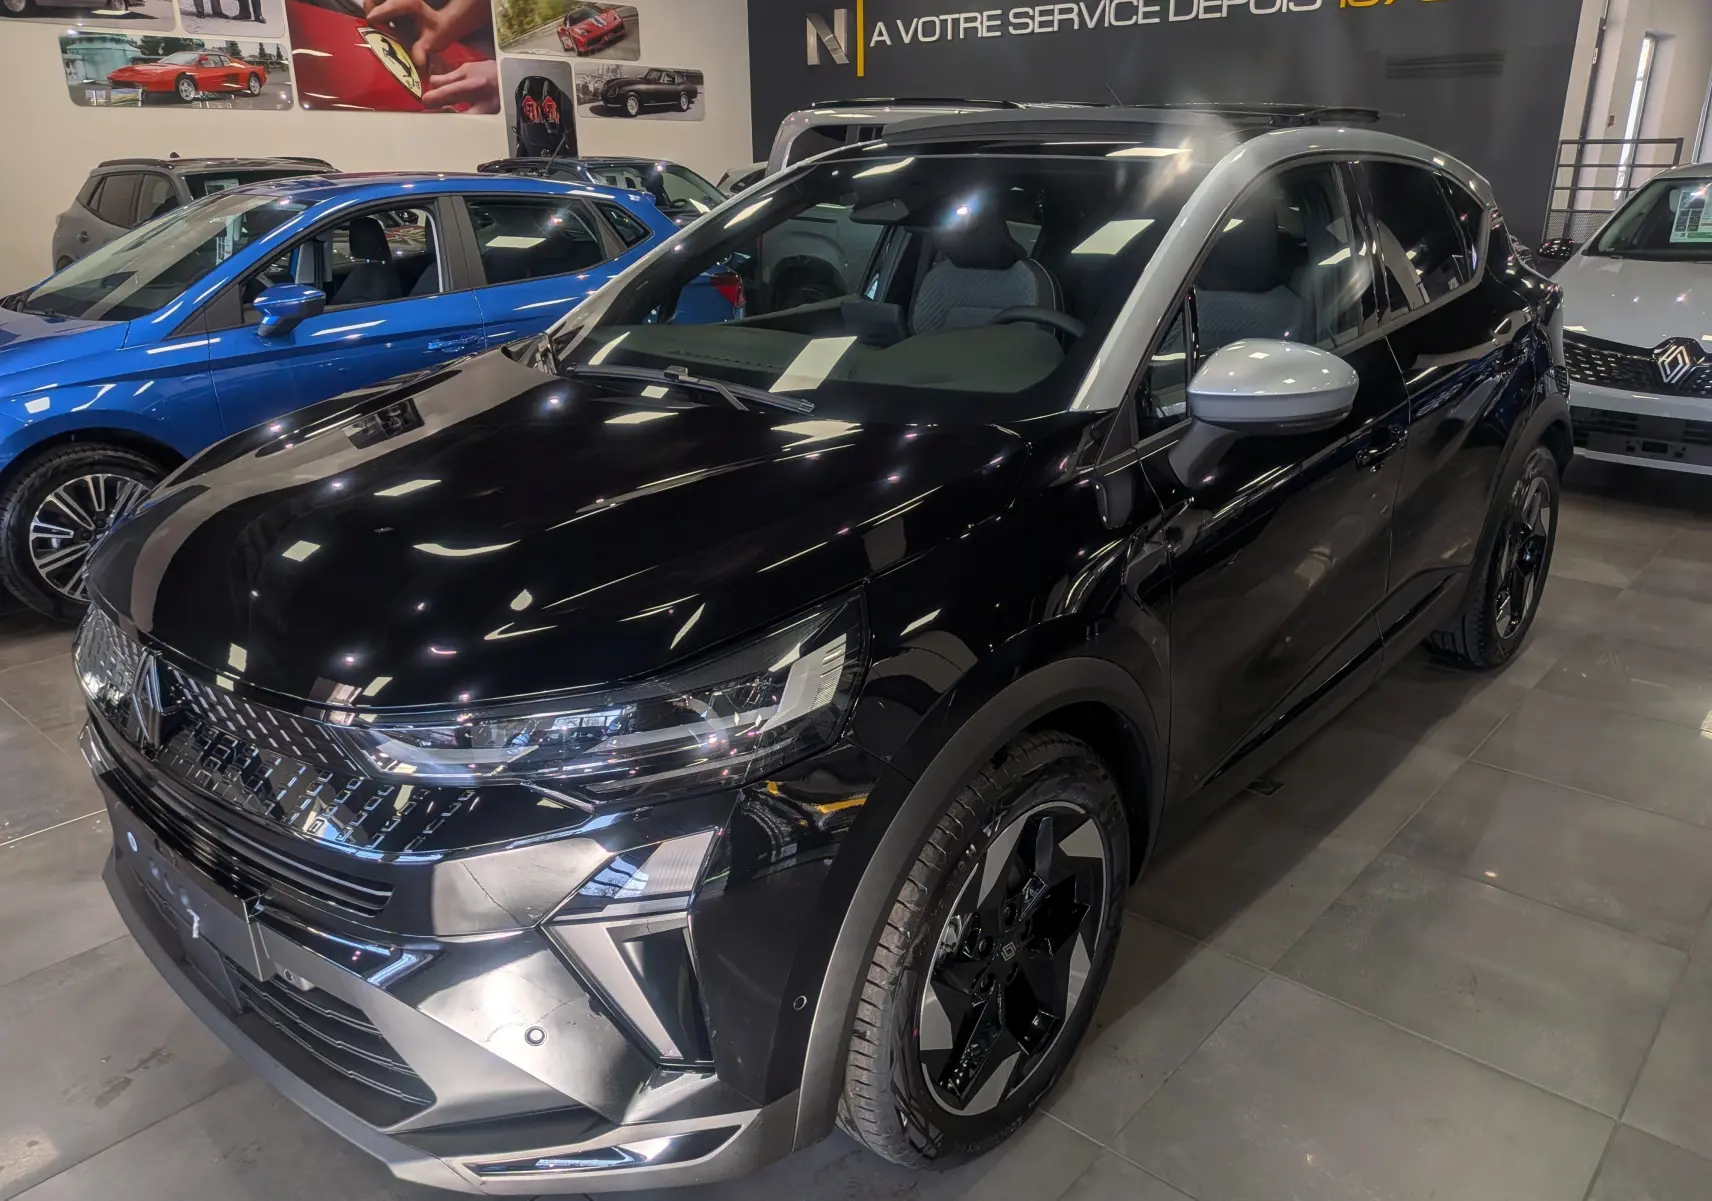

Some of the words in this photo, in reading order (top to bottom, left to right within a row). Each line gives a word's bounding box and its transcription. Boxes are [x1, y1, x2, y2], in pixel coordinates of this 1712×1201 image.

[806, 8, 849, 65] N
[870, 21, 892, 47] A
[896, 10, 1002, 44] VOTRE
[1008, 0, 1160, 35] SERVICE
